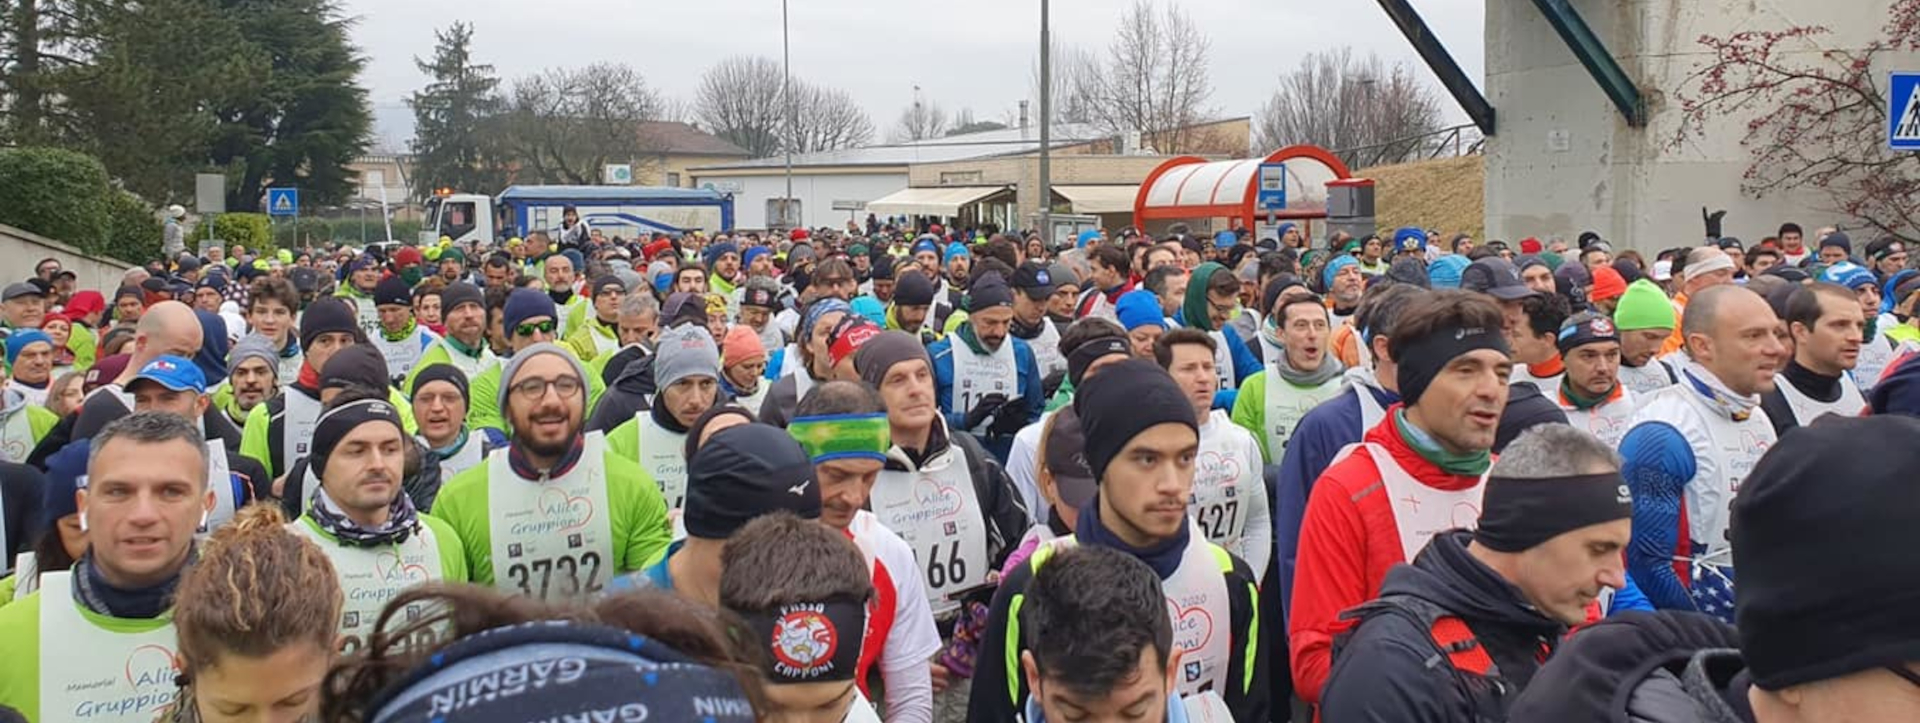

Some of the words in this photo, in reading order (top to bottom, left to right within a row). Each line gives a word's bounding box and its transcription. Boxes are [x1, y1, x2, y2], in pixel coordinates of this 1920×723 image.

[546, 502, 580, 516] Alice
[511, 518, 580, 537] Gruppioni
[508, 551, 602, 600] 3732
[426, 657, 588, 719] GARMIN
